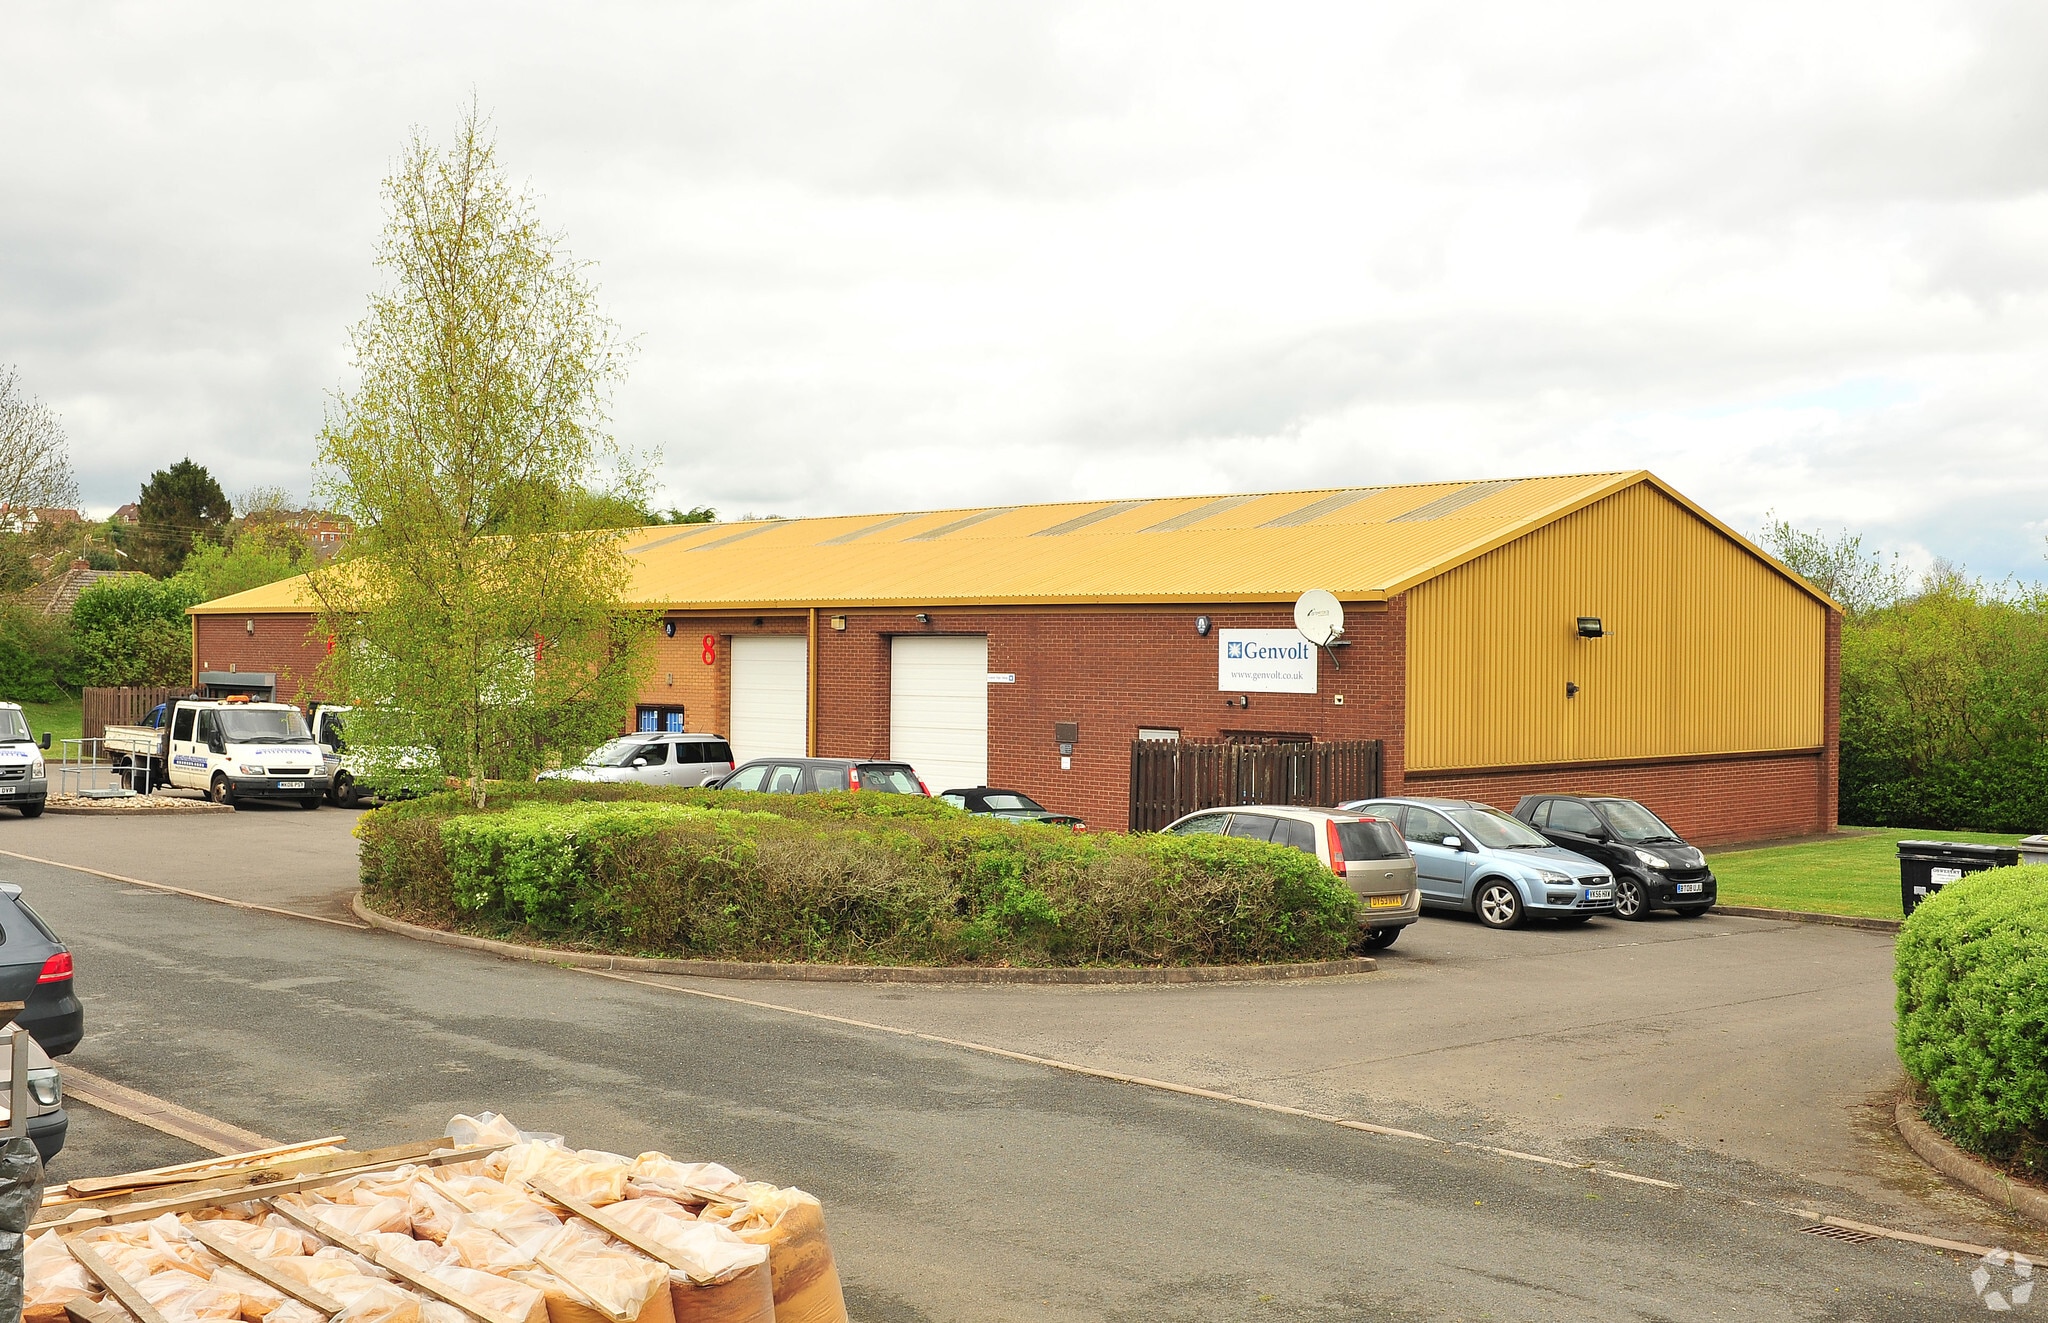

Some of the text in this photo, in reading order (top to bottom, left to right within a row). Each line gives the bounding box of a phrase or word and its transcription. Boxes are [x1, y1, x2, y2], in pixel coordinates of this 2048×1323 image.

[702, 633, 716, 666] 8
[1244, 641, 1309, 660] Genvolt
[1231, 670, 1304, 682] www.genvolt.co.uk
[1372, 896, 1388, 906] DY53
